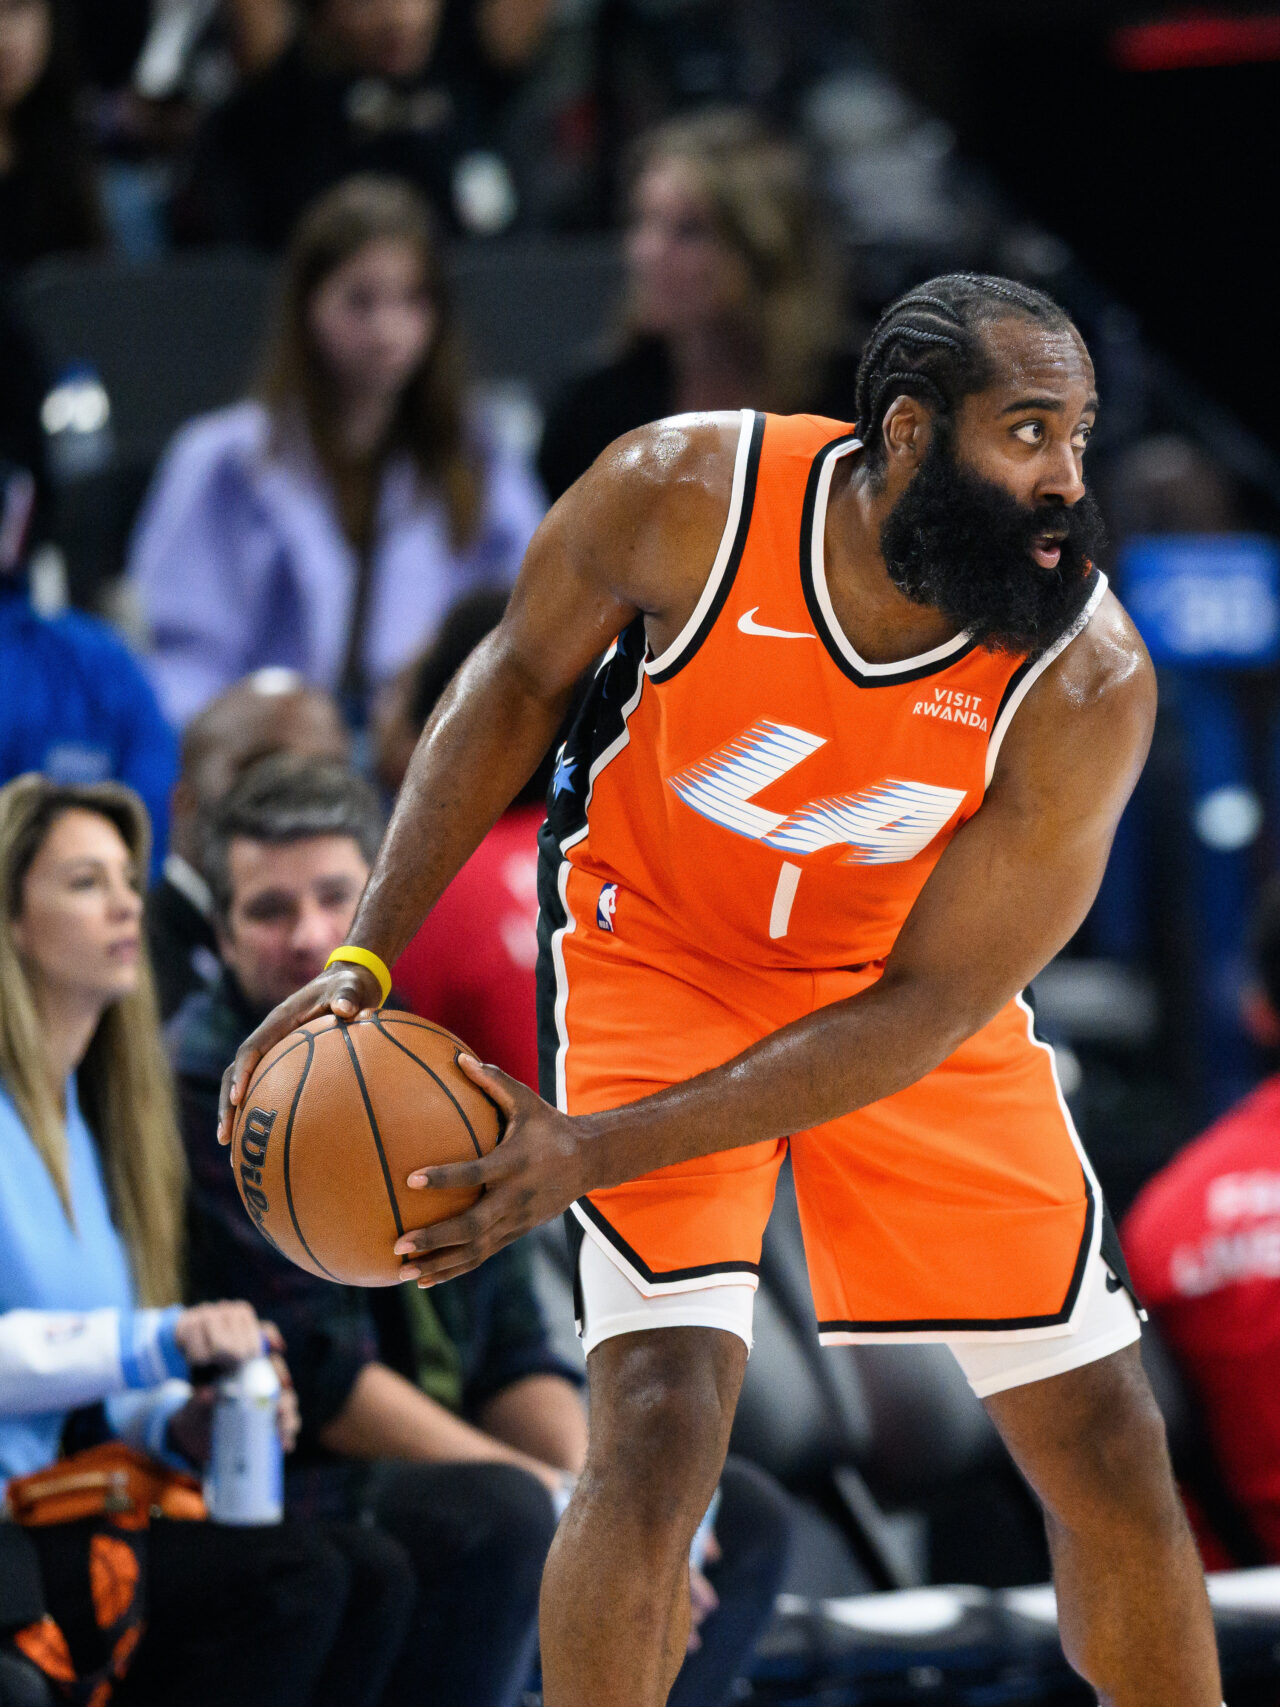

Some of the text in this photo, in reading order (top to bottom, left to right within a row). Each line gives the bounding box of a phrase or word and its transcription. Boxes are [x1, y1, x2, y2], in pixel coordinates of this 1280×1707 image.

[912, 702, 988, 732] RWANDA
[934, 688, 982, 711] VISIT
[769, 860, 802, 939] 1
[240, 1106, 286, 1256] Wils
